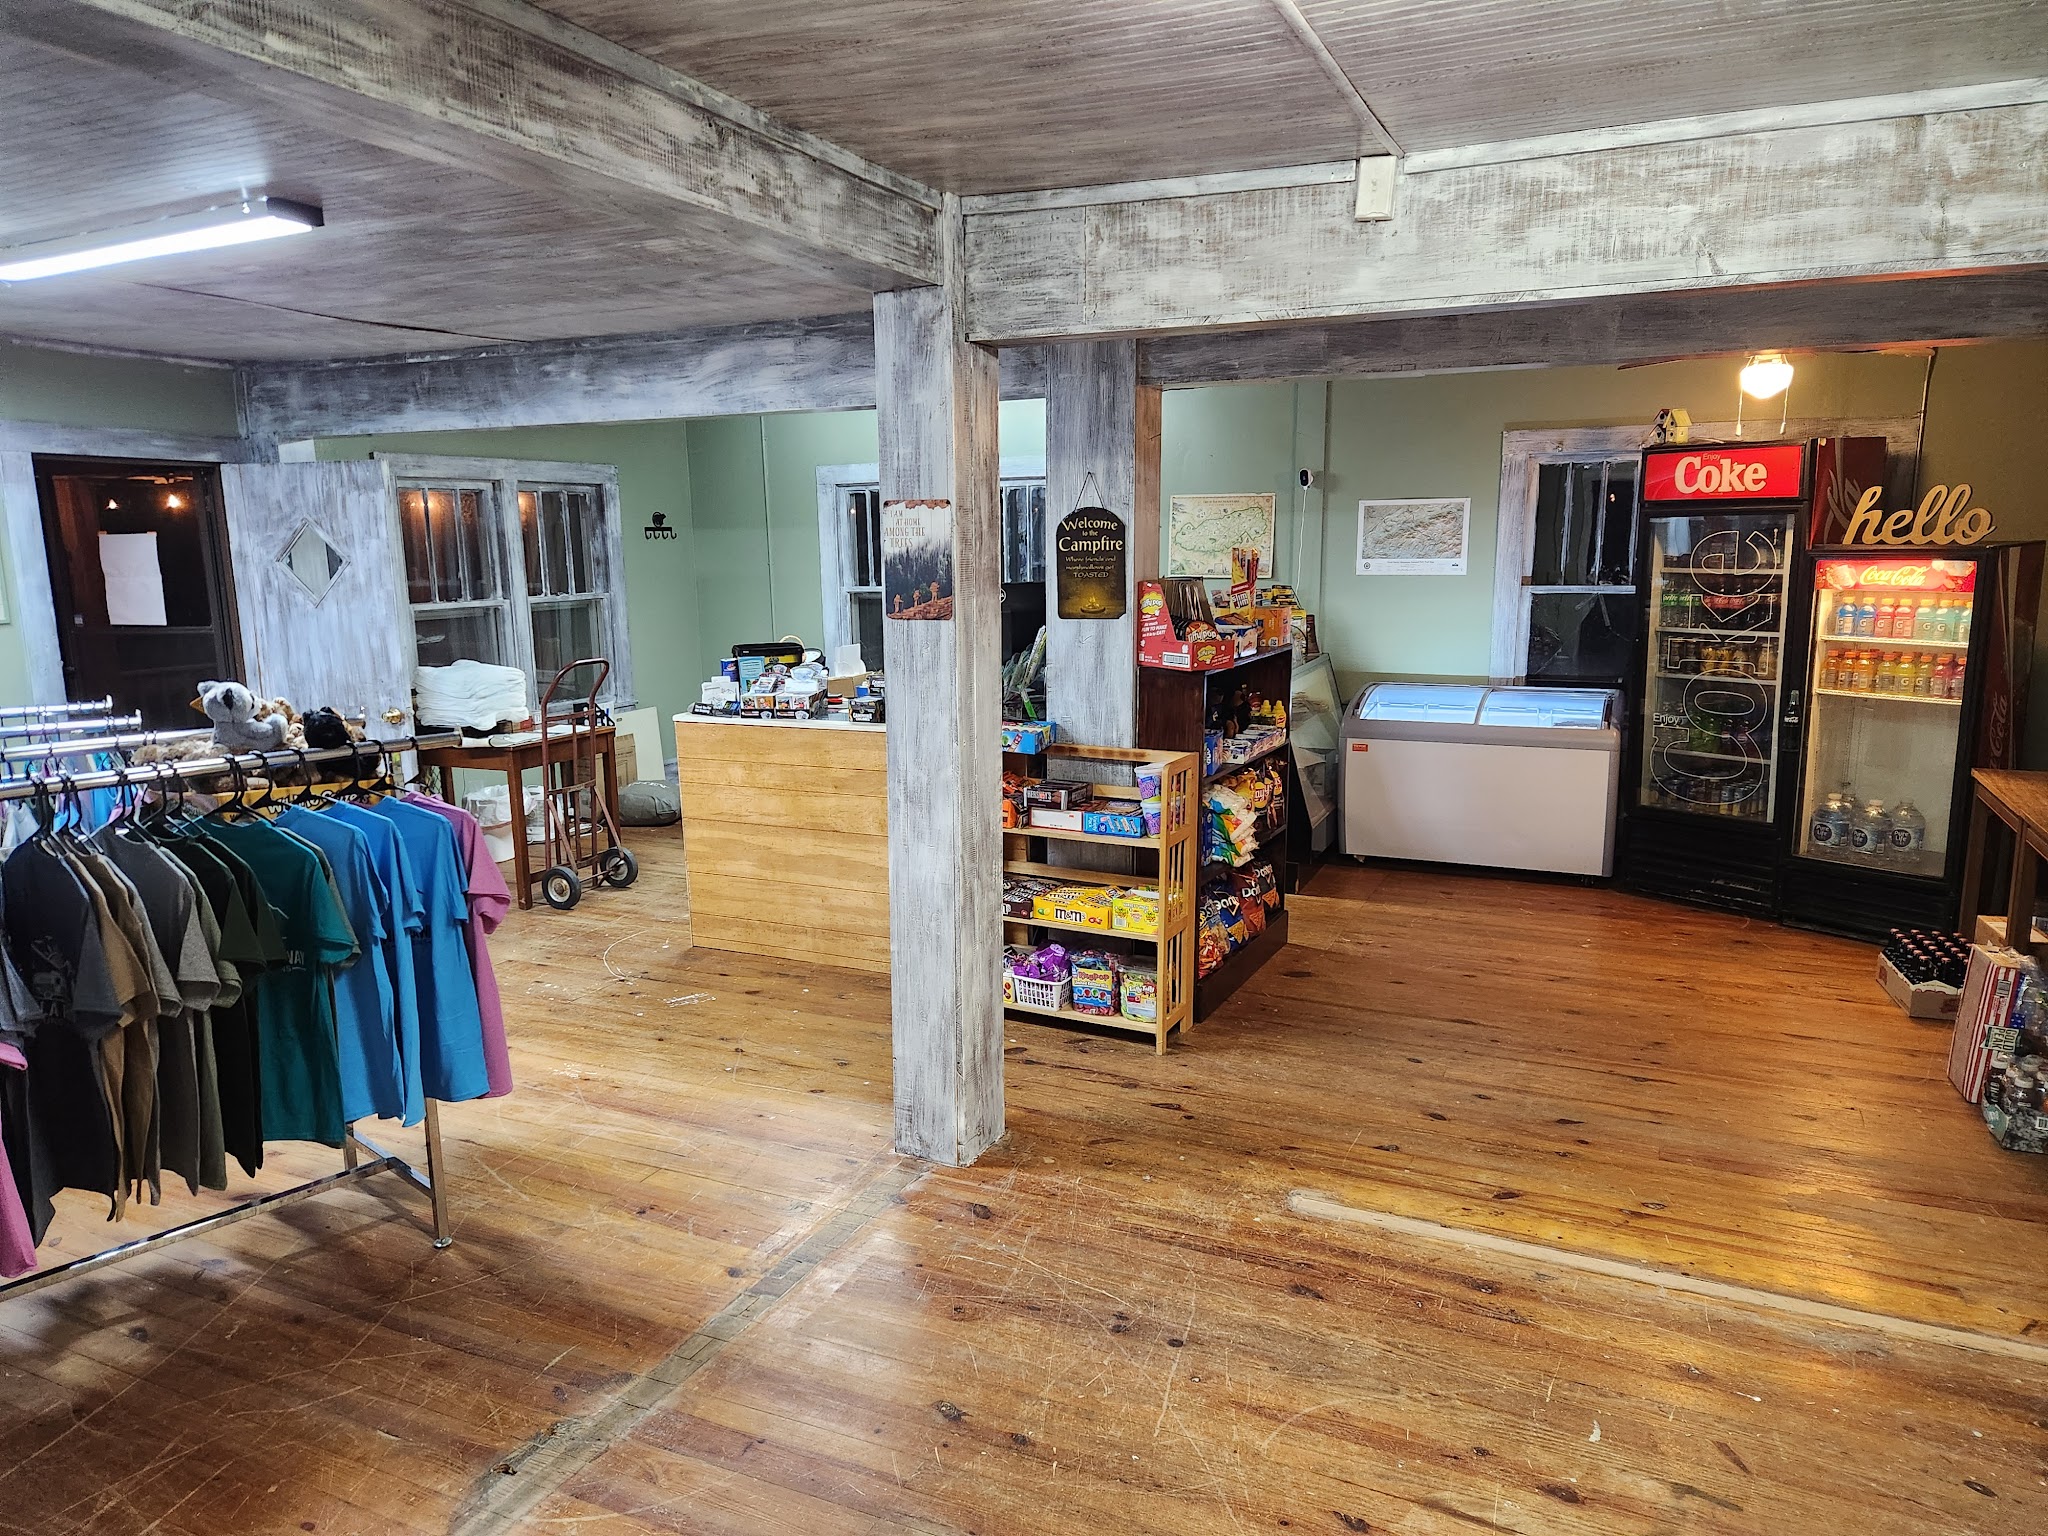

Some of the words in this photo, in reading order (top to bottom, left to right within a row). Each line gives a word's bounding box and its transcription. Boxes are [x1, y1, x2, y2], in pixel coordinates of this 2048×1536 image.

[1702, 453, 1721, 462] Enjoy
[1674, 455, 1768, 494] Coke
[1842, 483, 1997, 546] hello
[1061, 516, 1118, 532] Welcome
[884, 527, 910, 537] AMONG
[912, 527, 926, 537] THE
[890, 538, 914, 548] TREES
[1058, 535, 1124, 554] Campfire
[1860, 566, 1931, 586] Coca-Cola
[1877, 620, 1884, 628] G
[1896, 620, 1904, 628] G
[1923, 622, 1931, 630] G
[1938, 624, 1946, 632] G
[1203, 630, 1217, 640] pop
[1901, 678, 1910, 686] G
[1653, 712, 1681, 726] Enjoy
[1992, 1028, 2006, 1050] PEAK
[2003, 1030, 2018, 1050] GOLD
